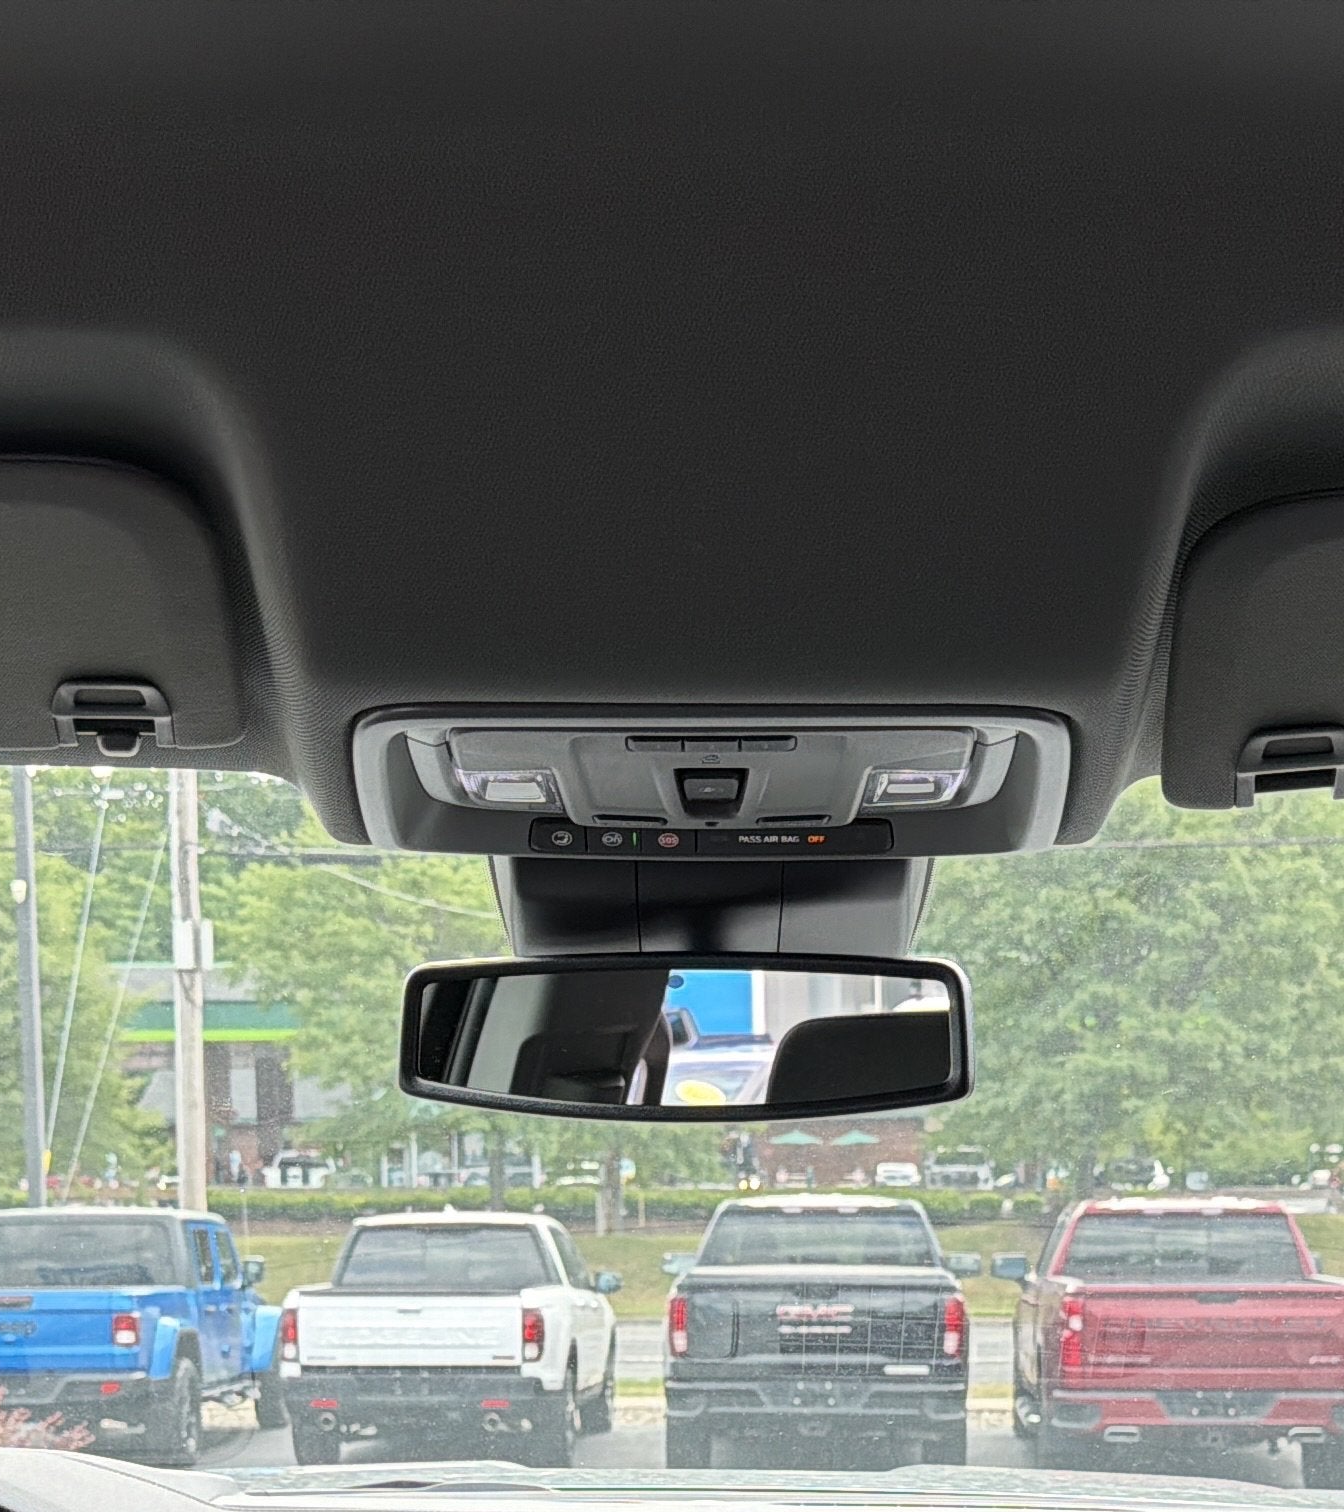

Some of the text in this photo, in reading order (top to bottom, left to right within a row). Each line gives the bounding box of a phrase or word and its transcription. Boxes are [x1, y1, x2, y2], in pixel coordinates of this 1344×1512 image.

[738, 835, 826, 843] PASS AIR BAG OFF
